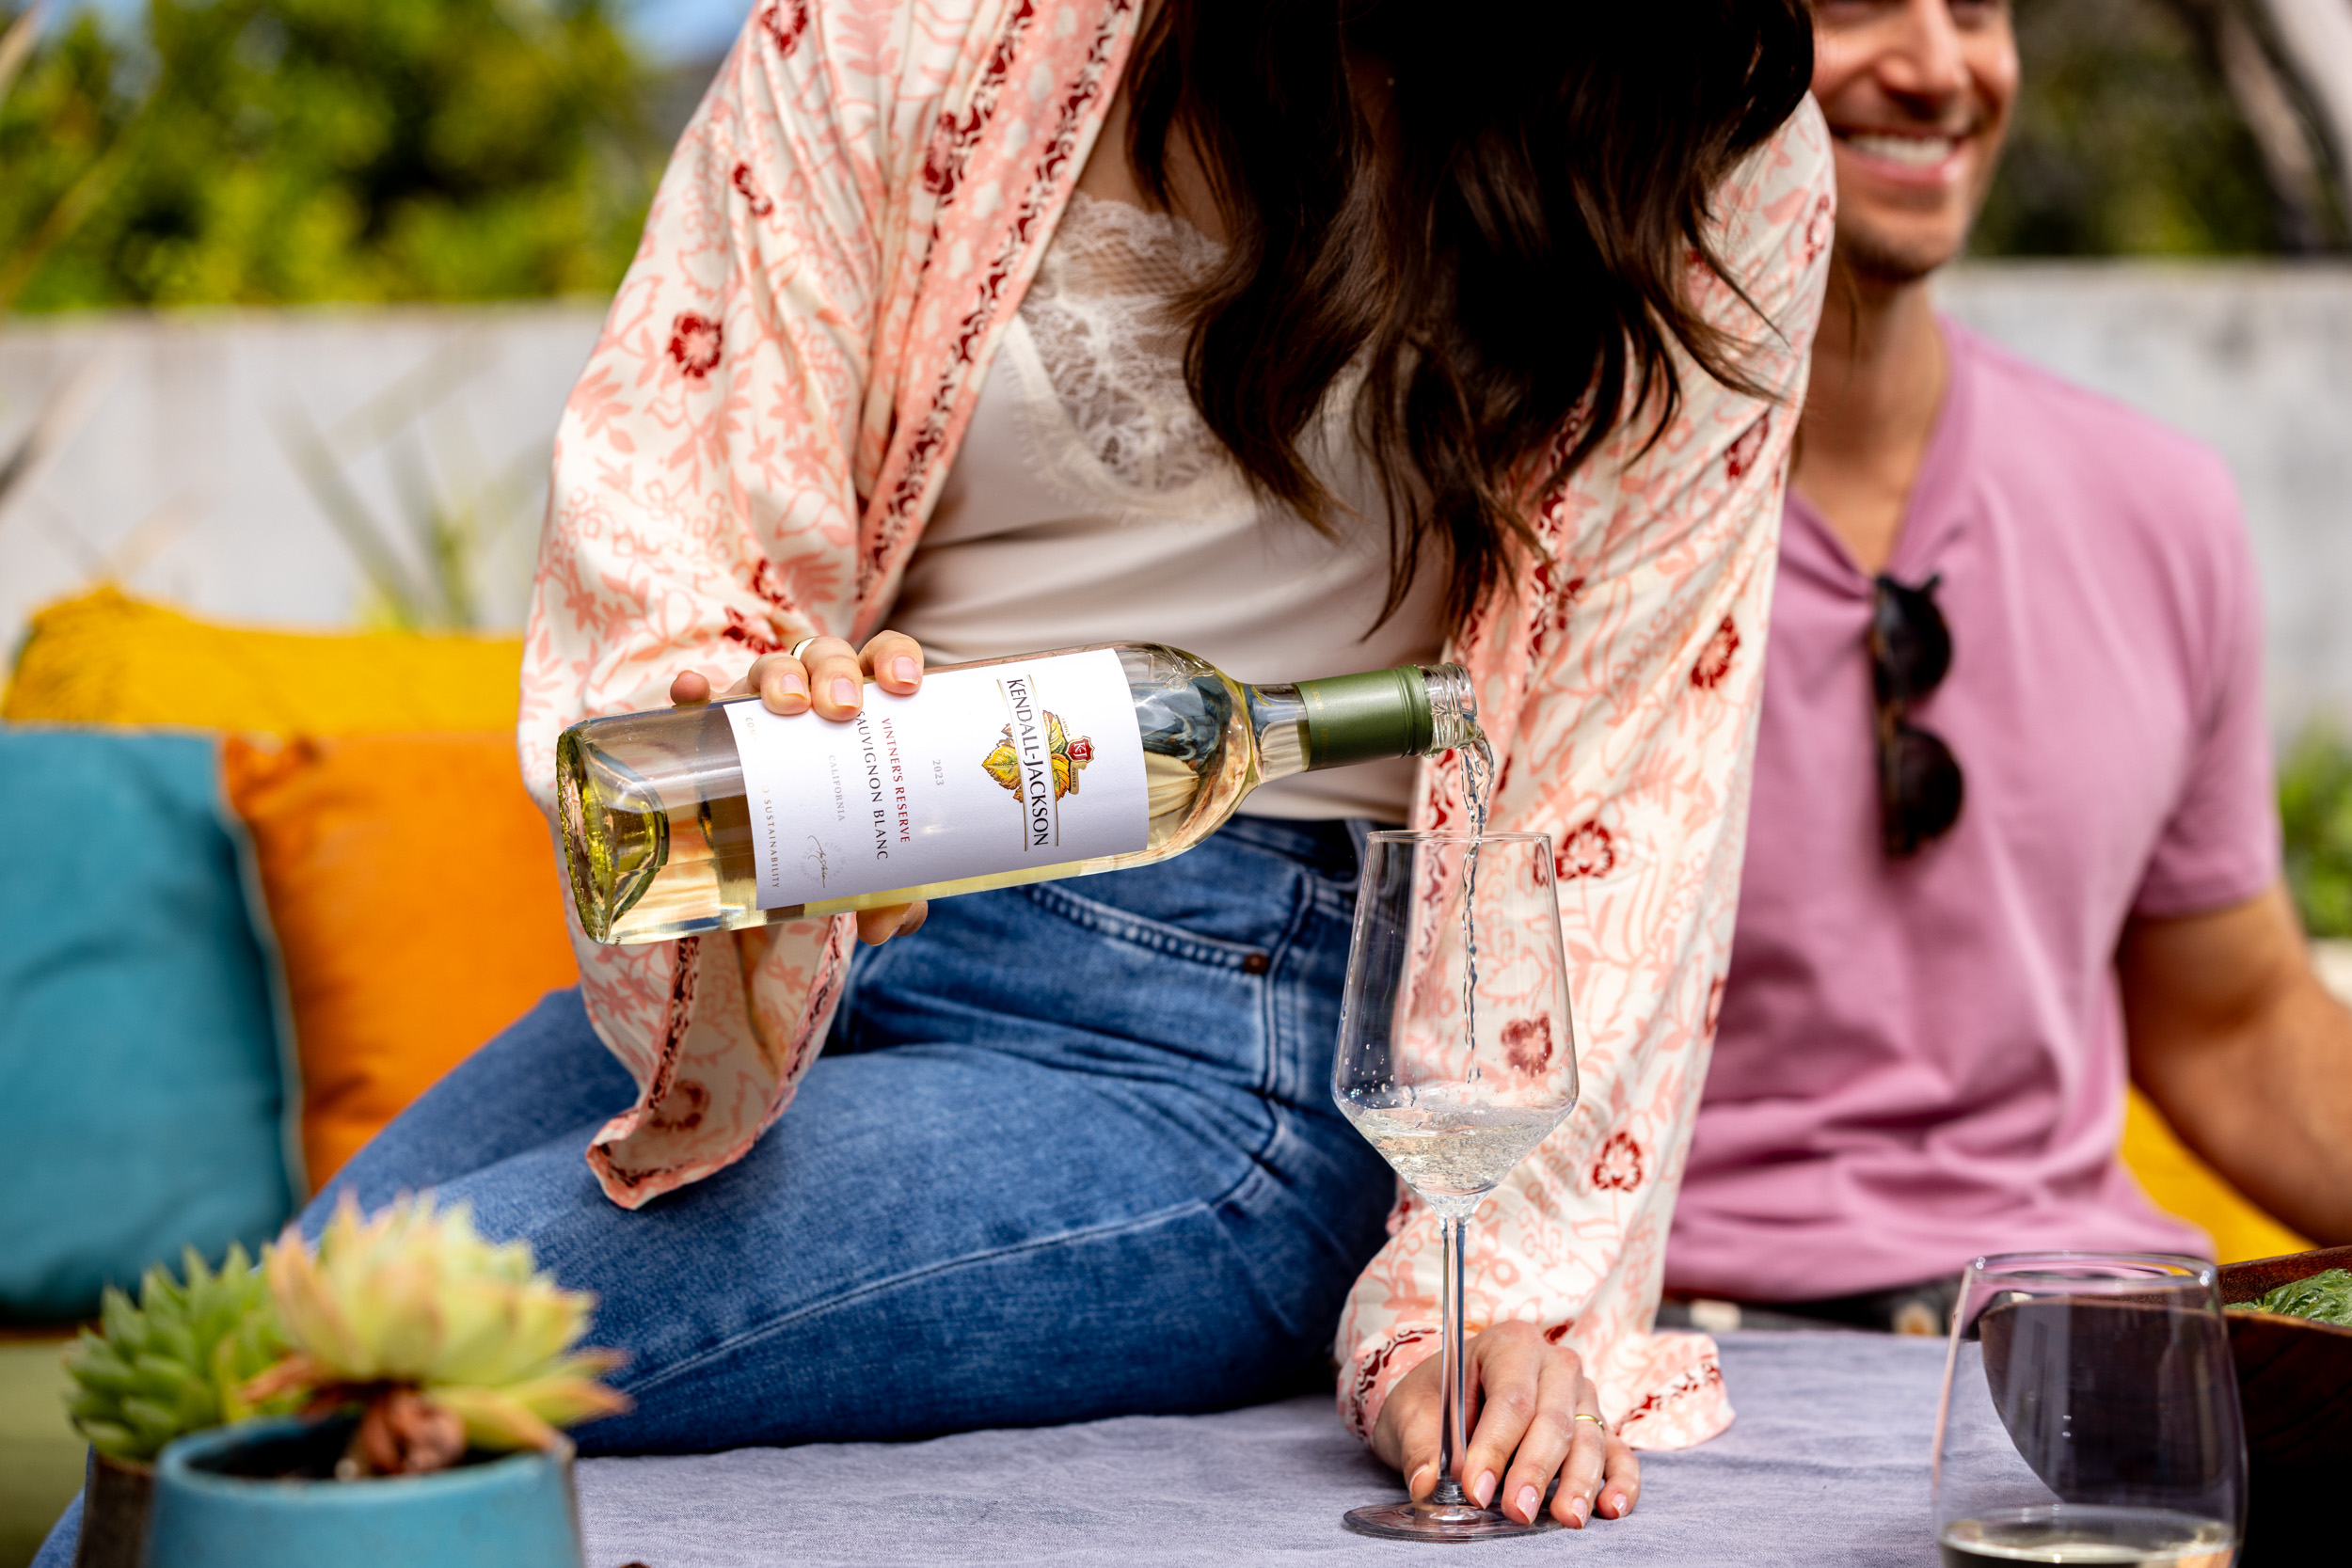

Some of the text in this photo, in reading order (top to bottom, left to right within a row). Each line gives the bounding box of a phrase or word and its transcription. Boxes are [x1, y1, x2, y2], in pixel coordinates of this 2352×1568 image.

[828, 754, 846, 822] CALIFORNIA
[855, 711, 889, 860] SAUVIGNON BLANC
[882, 718, 911, 843] VINTNER'S RESERVE
[932, 759, 945, 786] 2023
[1007, 678, 1049, 846] KENDALL-JACKSON
[764, 800, 780, 888] SUSTAINABILITY
